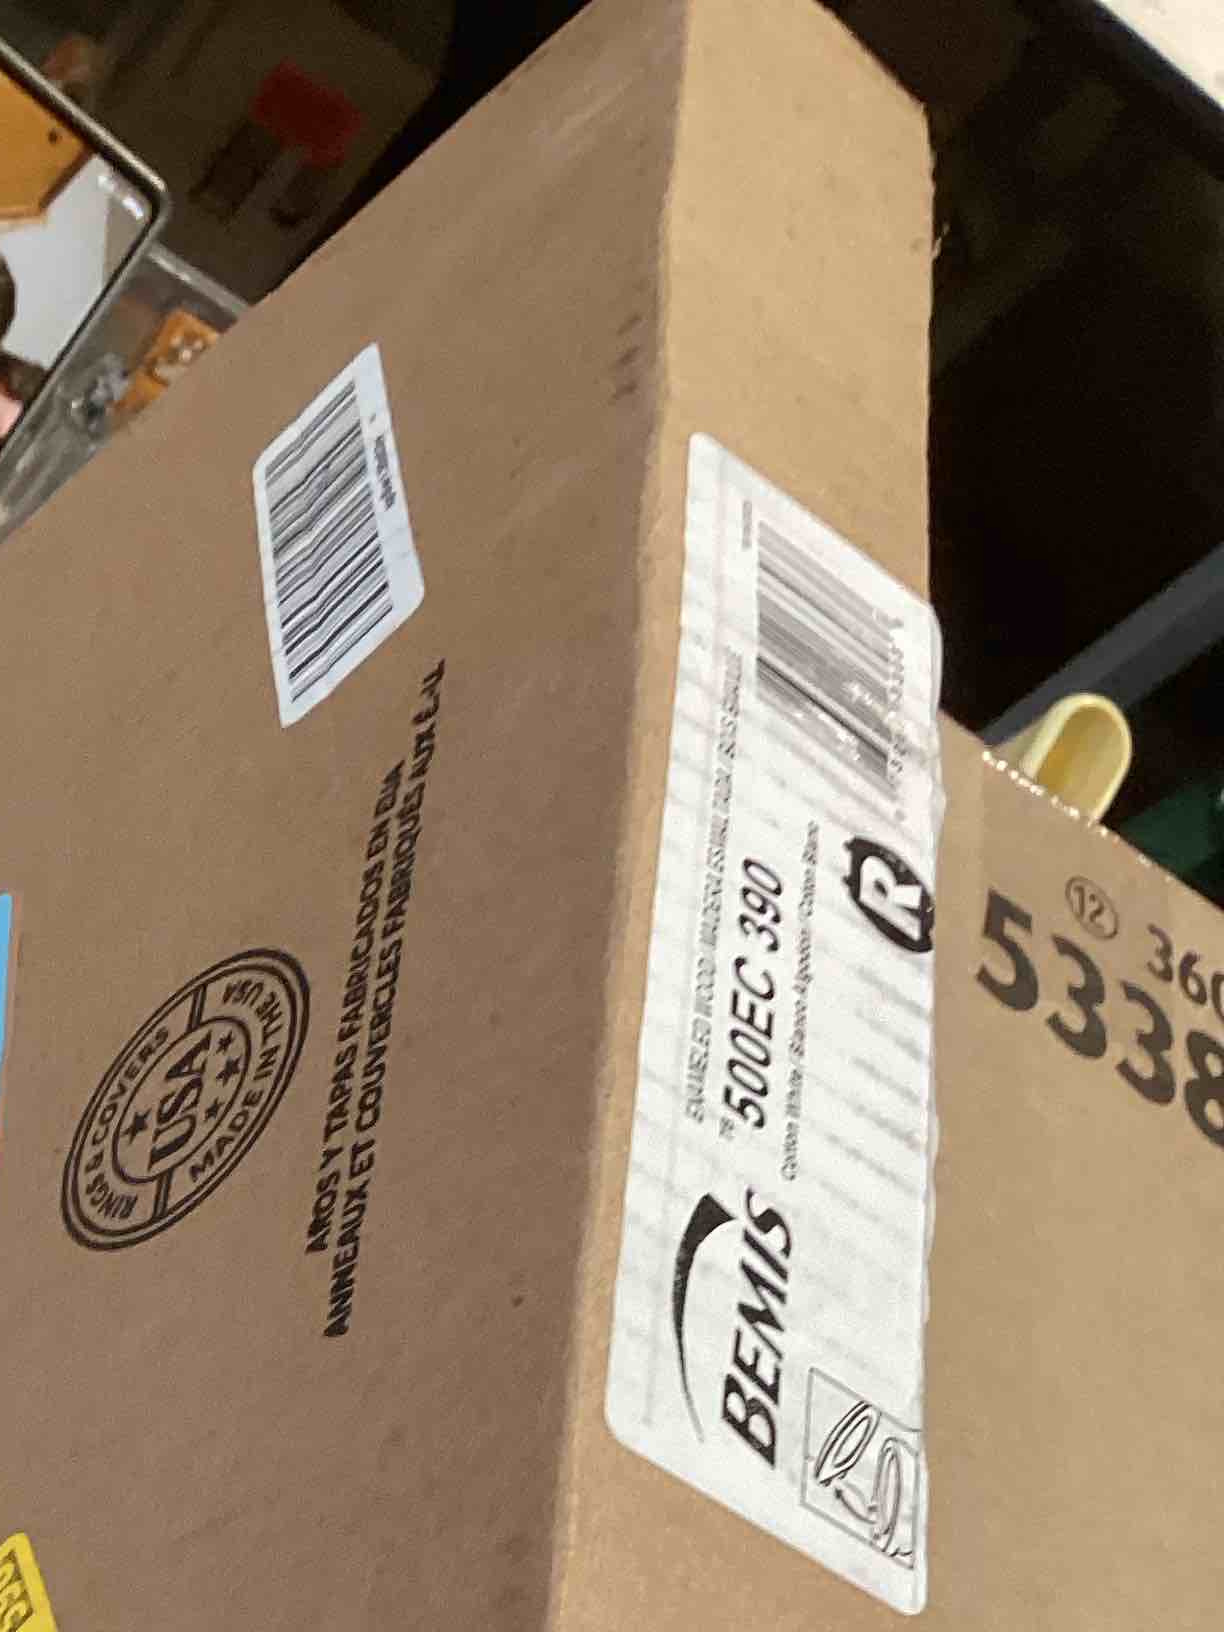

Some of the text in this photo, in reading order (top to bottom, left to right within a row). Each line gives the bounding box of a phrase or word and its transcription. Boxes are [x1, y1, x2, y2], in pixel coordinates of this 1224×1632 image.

[337, 860, 385, 1042] FABRICADOS
[738, 857, 783, 953] 390
[92, 1026, 170, 1146] COVERS
[148, 1029, 212, 1172] USA
[189, 979, 284, 1183] MADE IN THE USA
[324, 1044, 357, 1141] TAPAS
[723, 955, 776, 1129] 500EC
[86, 1174, 138, 1219] RINGS
[323, 1179, 371, 1338] ANNEAUX
[354, 939, 403, 1132] COUVERCLES
[305, 1168, 342, 1256] AROS
[720, 1187, 796, 1466] BEMIS
